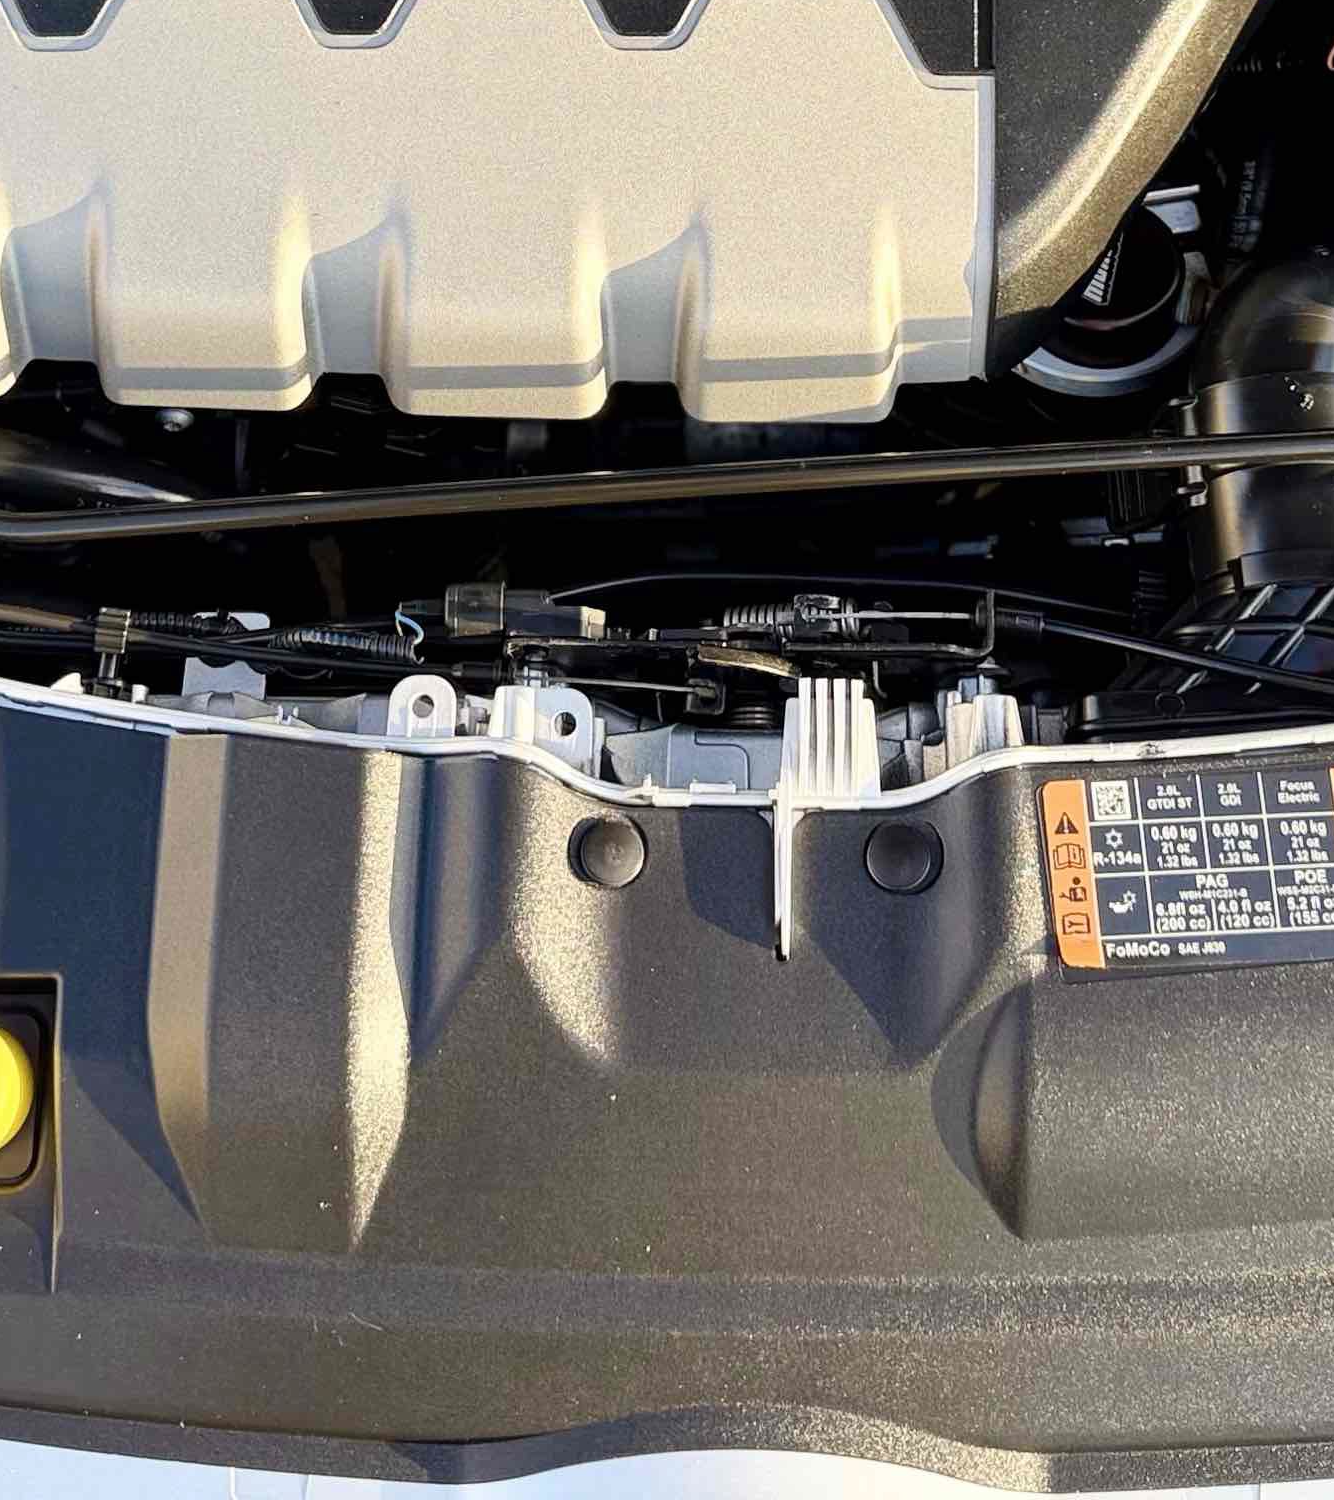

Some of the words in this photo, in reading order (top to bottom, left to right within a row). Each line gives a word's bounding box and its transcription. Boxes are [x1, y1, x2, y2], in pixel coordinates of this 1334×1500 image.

[1279, 780, 1315, 791] Focus
[1177, 797, 1193, 809] ST
[1277, 791, 1320, 804] Electric
[1151, 825, 1178, 840] 0.60
[1180, 825, 1197, 843] kg
[1212, 822, 1239, 838] 0.60
[1241, 821, 1258, 840] kg
[1280, 820, 1307, 836] 0.60
[1309, 819, 1327, 837] kg
[1161, 842, 1175, 854] 21
[1176, 843, 1191, 854] oz
[1223, 838, 1236, 851] 21
[1237, 840, 1252, 851] oz
[1291, 836, 1304, 849] 21
[1306, 837, 1321, 848] oz
[1093, 851, 1142, 866] R-134a
[1157, 856, 1180, 868] 1.32
[1181, 854, 1198, 867] lbs
[1219, 852, 1240, 865] 1.32
[1242, 851, 1260, 864] lbs
[1287, 849, 1310, 863] 1.32
[1310, 849, 1329, 862] lbs
[1195, 873, 1229, 889] PAG
[1293, 869, 1328, 885] POE
[1188, 904, 1206, 916] oz
[1217, 899, 1239, 914] 4.0
[1241, 898, 1252, 913] fl
[1254, 900, 1272, 913] oz
[1287, 896, 1308, 911] 5.2
[1310, 896, 1322, 911] fl
[1156, 916, 1186, 934] (200
[1189, 915, 1212, 932] cc)
[1220, 913, 1250, 931] (120
[1253, 912, 1275, 928] cc)
[1289, 910, 1320, 927] (155
[1105, 941, 1170, 958] FoMoCo
[1178, 942, 1200, 956] SAE
